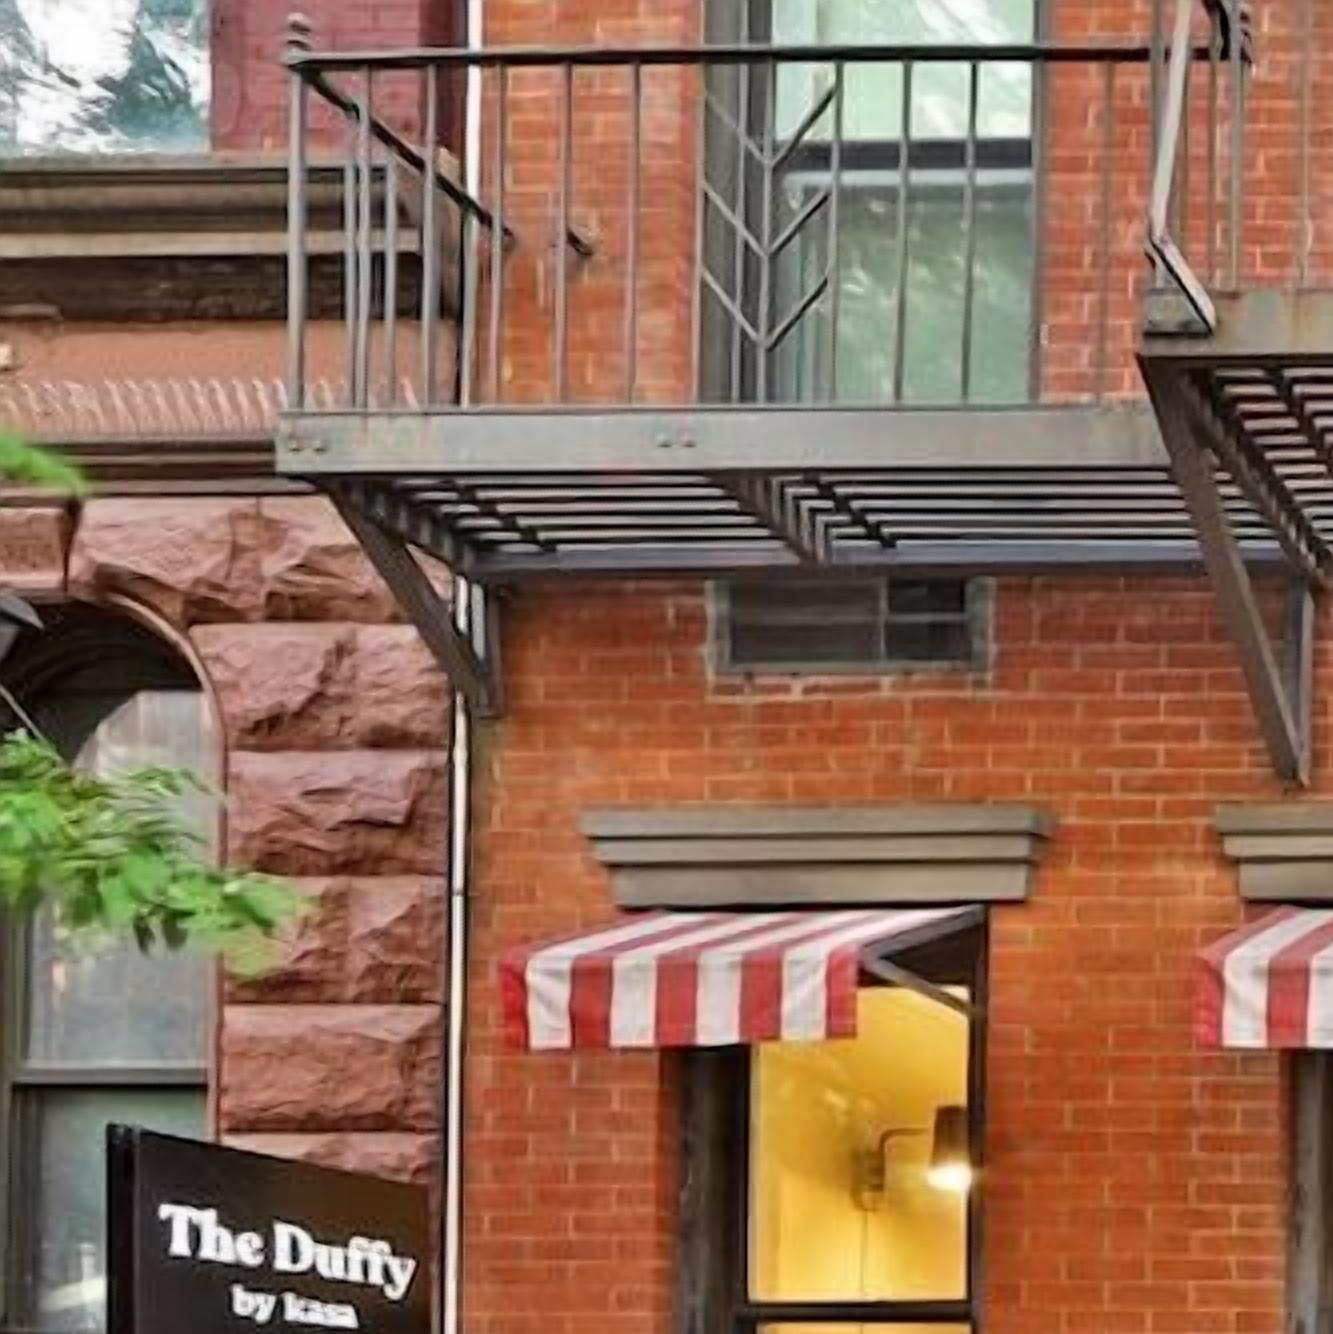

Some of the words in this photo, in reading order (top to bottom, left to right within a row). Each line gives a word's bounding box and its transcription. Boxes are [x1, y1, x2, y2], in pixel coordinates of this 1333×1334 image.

[158, 1203, 265, 1268] The
[273, 1220, 416, 1301] Duffy
[231, 1283, 277, 1324] by
